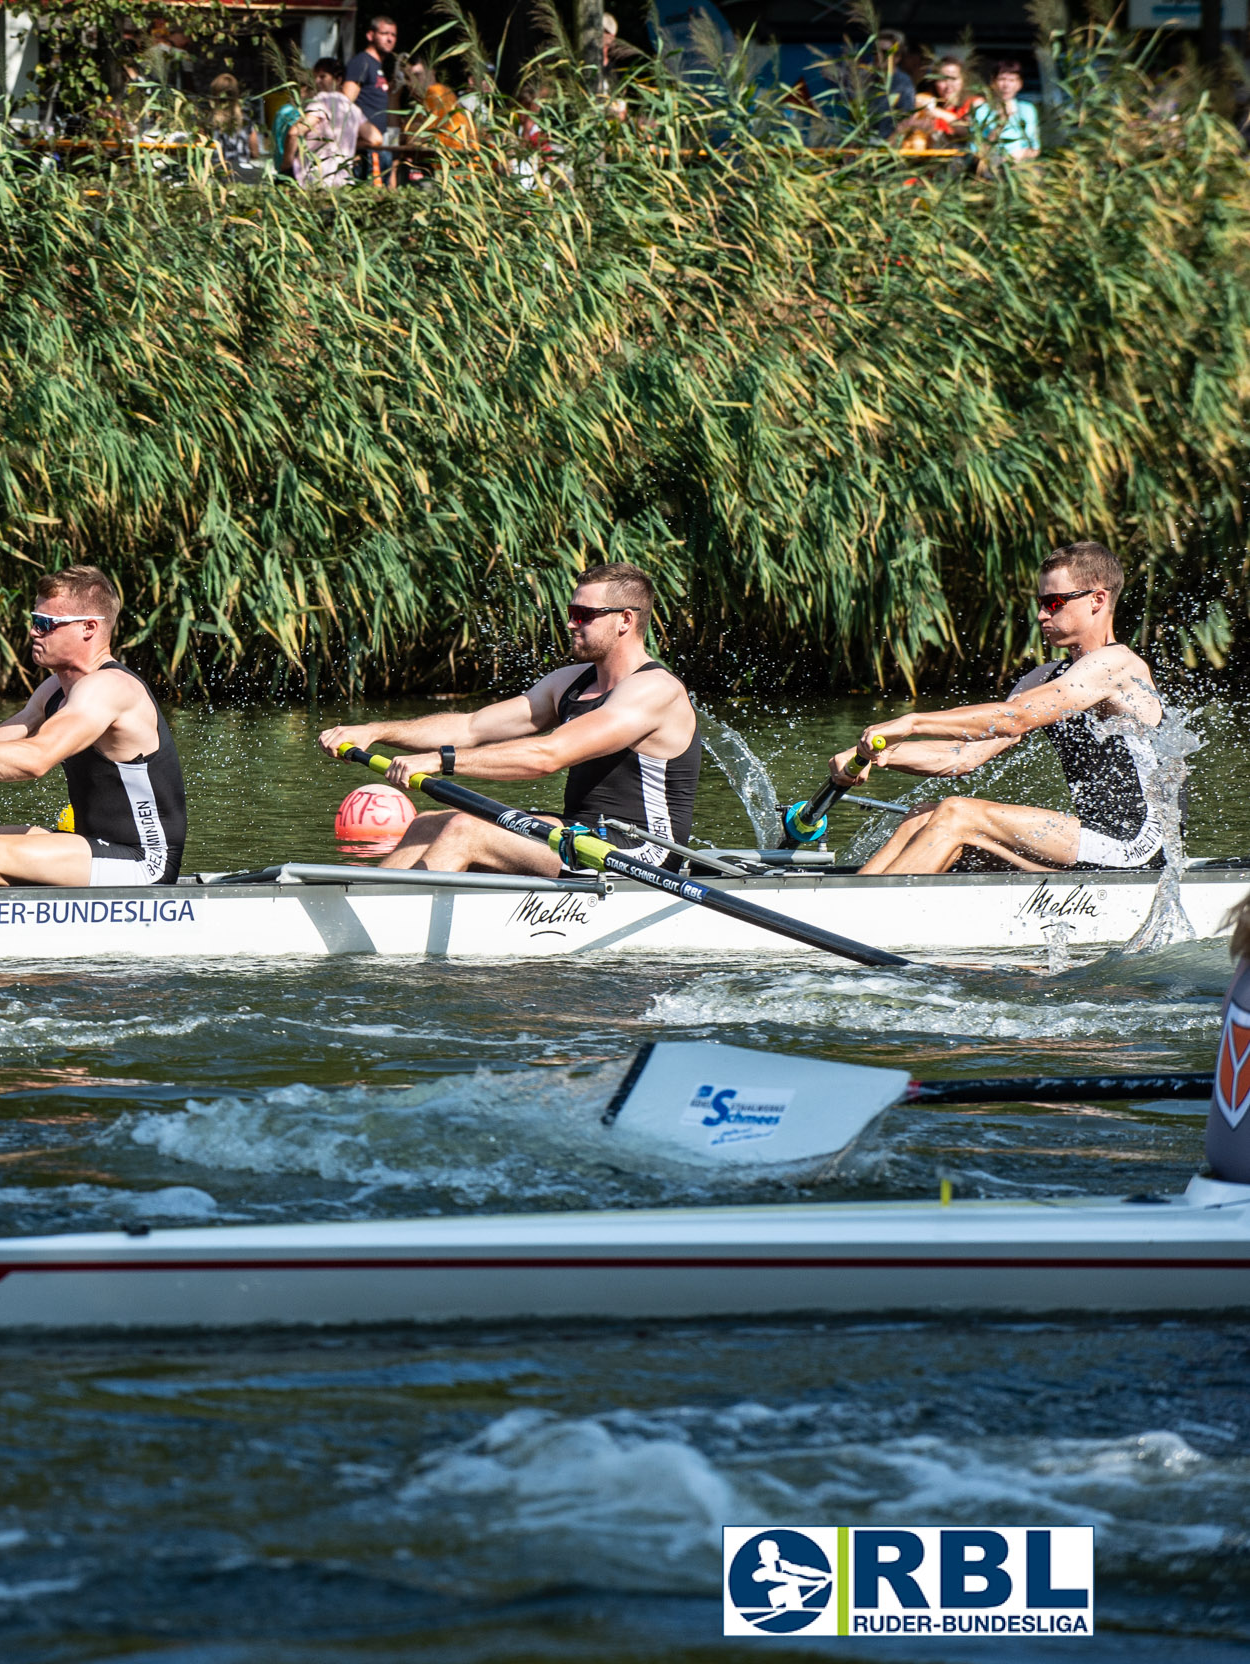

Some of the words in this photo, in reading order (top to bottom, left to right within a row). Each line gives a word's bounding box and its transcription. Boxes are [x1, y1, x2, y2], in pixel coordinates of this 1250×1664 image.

[136, 801, 161, 847] MINDEN
[496, 810, 534, 838] Melitta
[630, 866, 662, 887] SCHNELL.
[662, 879, 680, 893] GUT.
[683, 884, 704, 900] RBL
[1016, 878, 1101, 918] Melitta
[505, 890, 590, 927] Melitta
[701, 1089, 781, 1126] Schmees
